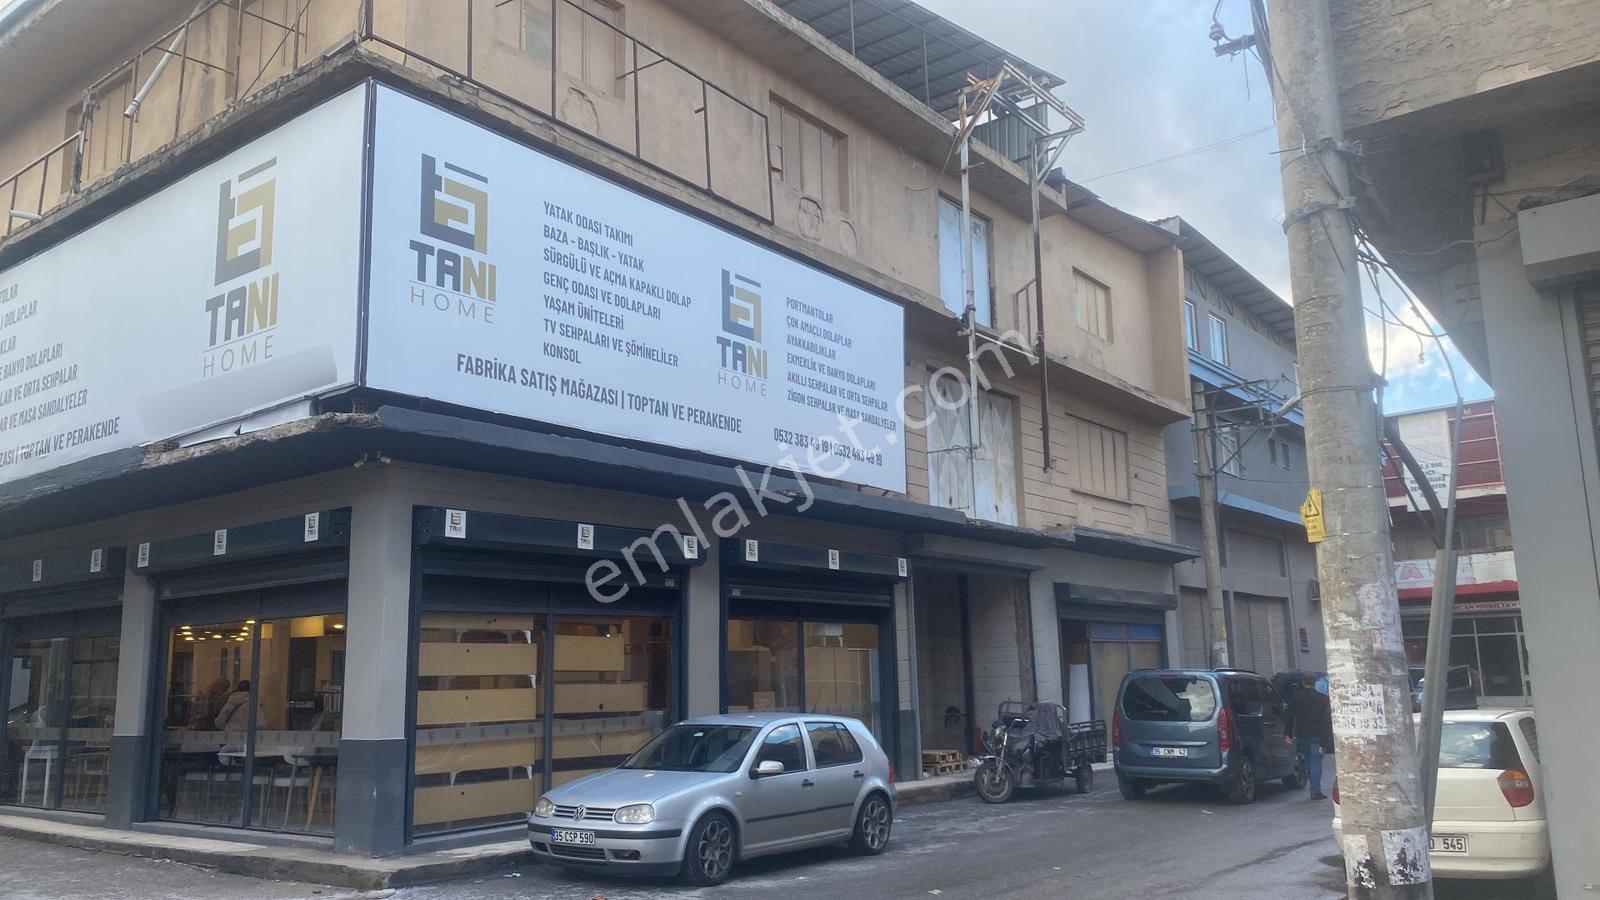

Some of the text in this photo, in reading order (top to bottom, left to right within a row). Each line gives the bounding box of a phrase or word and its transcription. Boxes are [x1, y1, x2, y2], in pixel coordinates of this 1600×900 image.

[544, 201, 633, 246] YATAK ODASI TAKIMI
[544, 224, 568, 245] BAZA
[578, 237, 609, 260] BAŞLIK
[618, 251, 644, 272] YATAK
[410, 239, 496, 302] TANI
[544, 246, 691, 308] SÜRGÜLÜ VE AÇMA KAPAKLI DOLAP
[205, 272, 279, 347] TANI
[411, 286, 494, 324] HOME
[544, 272, 660, 320] GENÇ ODASI VE DOLAPLARI
[544, 294, 624, 330] YAŞAM ÜNİTELERİ
[786, 297, 833, 324] PORTMANTOLAR
[544, 318, 678, 367] TV SEHPALARI VE ŞÖMİNELİLER
[787, 315, 852, 348] ÇOK AMAÇLI DOLAPLAR
[787, 334, 836, 360] AYAKKABILIKLAR
[4, 358, 24, 379] BANYO
[25, 342, 63, 370] DOLAPLARI
[203, 335, 273, 378] HOME
[544, 342, 581, 363] KONSOL
[717, 336, 767, 379] TANI
[787, 352, 876, 391] EKMEKLİK VE BANYO DOLAPLARI
[14, 385, 22, 401] VE
[23, 378, 40, 398] ORTA
[42, 364, 78, 391] SEHPALAR
[457, 353, 516, 384] FABRİKA
[521, 368, 557, 396] SATIŞ
[561, 377, 618, 406] MAĞAZASI
[628, 393, 668, 417] TOPTAN
[672, 403, 684, 421] VE
[688, 407, 742, 433] PERAKENDE
[718, 371, 766, 397] HOME
[788, 371, 888, 411] AKILLI SEHPALAR VE ORTA SEHPALAR
[10, 413, 18, 429] VE
[19, 406, 36, 426] MASA
[38, 389, 88, 420] SANDALYELER
[788, 388, 805, 405] ZİGON
[806, 395, 836, 413] SEHPALAR
[861, 412, 896, 431] SANDALYELER
[20, 438, 50, 460] TOPTAN
[54, 434, 64, 451] VE
[66, 417, 120, 447] PERAKENDE
[774, 428, 793, 445] 0532
[794, 433, 808, 448] 383
[822, 440, 828, 453] 19
[876, 453, 882, 466] 19
[555, 831, 594, 843] 35 CSP 590
[1443, 838, 1463, 850] 545
